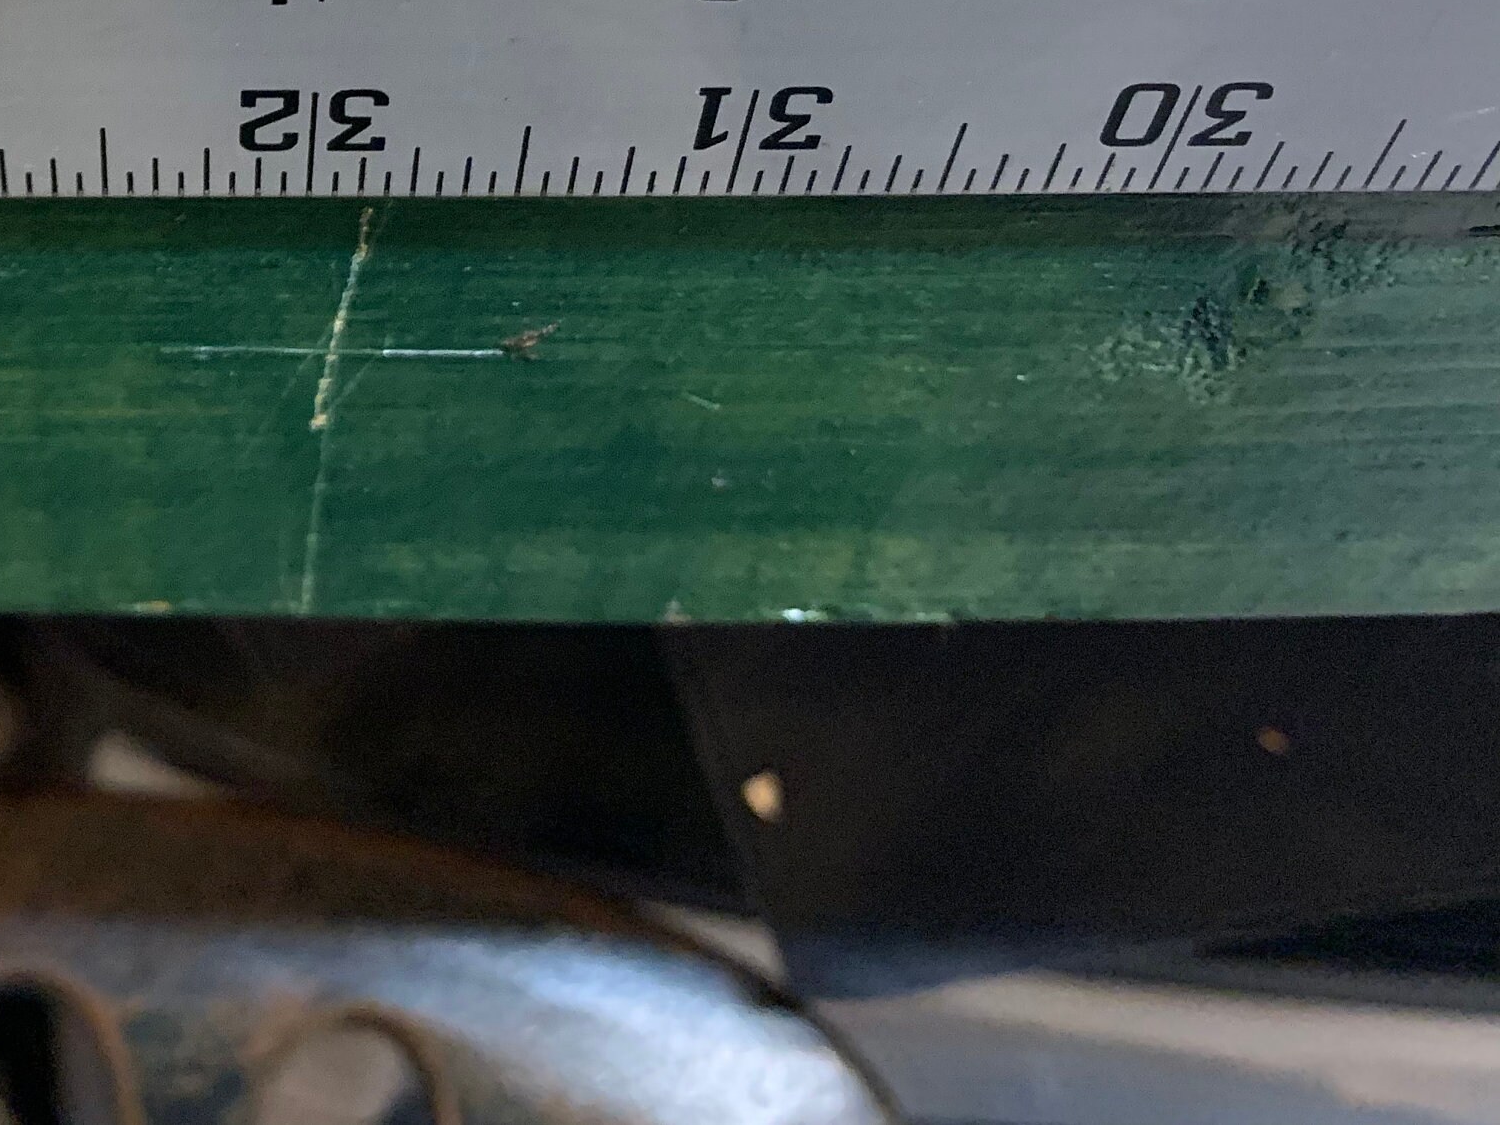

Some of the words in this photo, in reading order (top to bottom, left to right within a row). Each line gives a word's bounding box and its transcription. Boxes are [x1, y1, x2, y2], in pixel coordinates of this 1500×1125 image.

[238, 88, 390, 153] 32
[692, 86, 834, 151] 31
[1099, 81, 1274, 148] 30
